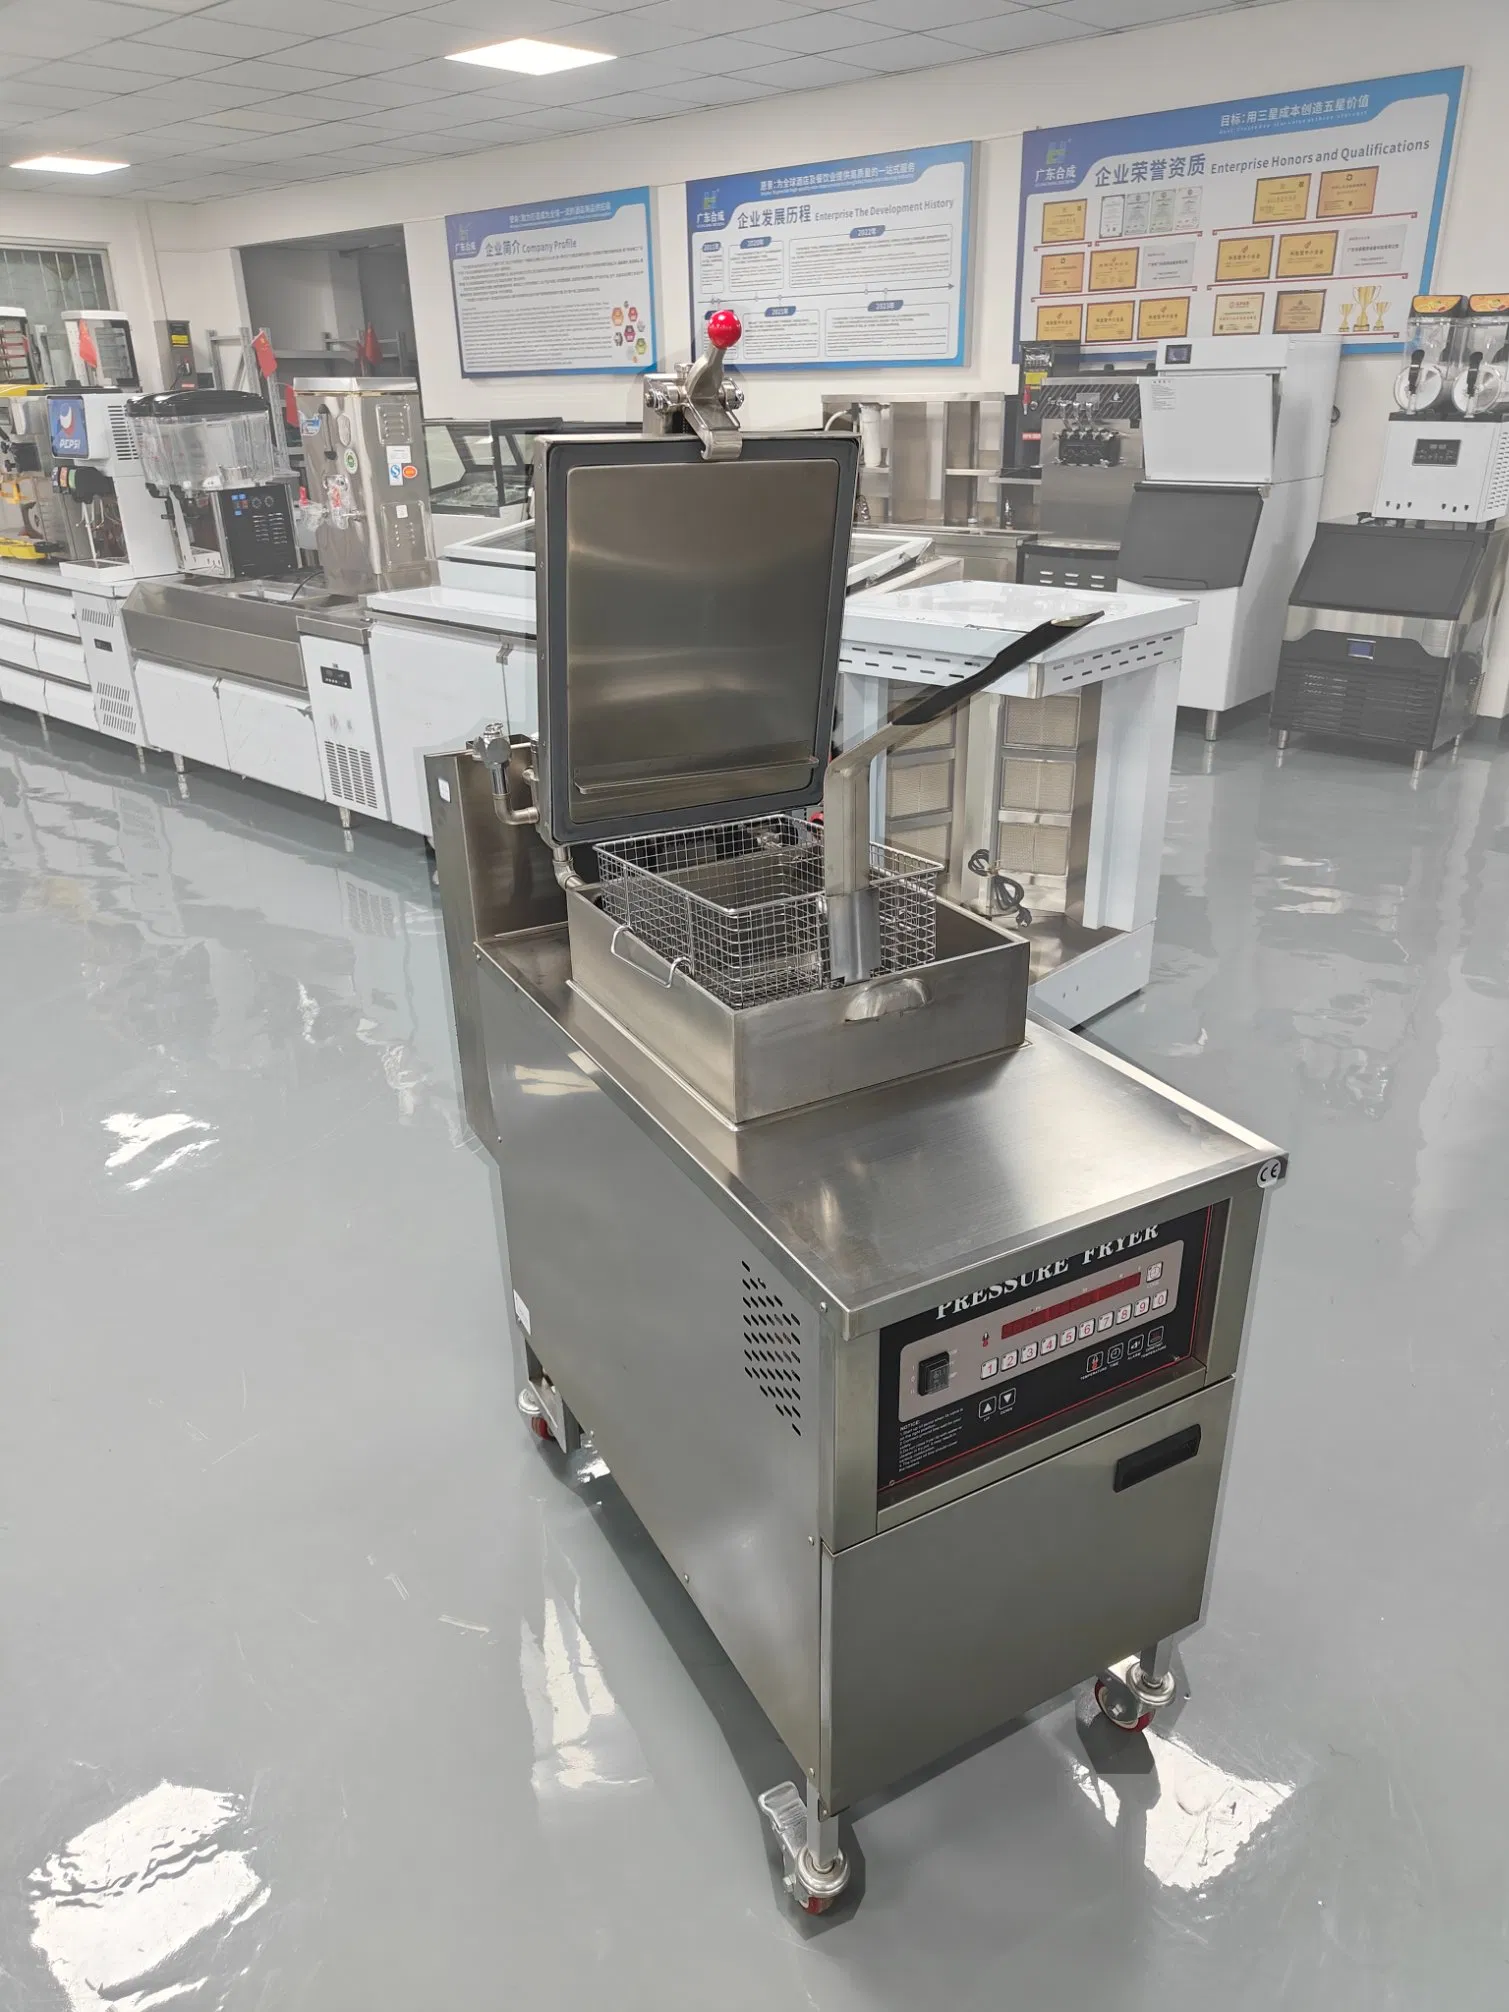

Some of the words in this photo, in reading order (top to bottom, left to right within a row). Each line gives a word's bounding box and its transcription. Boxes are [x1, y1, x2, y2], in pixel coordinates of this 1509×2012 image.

[1095, 153, 1206, 188] 企业荣誉资质
[1211, 156, 1269, 175] Enterprise
[1271, 151, 1313, 168] Honors
[1315, 147, 1337, 163] and
[1340, 137, 1430, 162] Qualifications
[737, 204, 812, 230] 企业发展历程
[815, 208, 853, 222] Enterprise
[855, 206, 868, 219] The
[870, 203, 923, 218] Development
[924, 198, 954, 213] History
[485, 239, 520, 258] 企业简介
[522, 242, 553, 255] Company
[554, 238, 577, 250] Profile
[60, 439, 81, 449] PEPSI
[1260, 1163, 1279, 1182] CE
[936, 1258, 1069, 1320] PRESSURE
[1082, 1224, 1159, 1266] FRYER
[1080, 1366, 1107, 1380] TEMPERATURE
